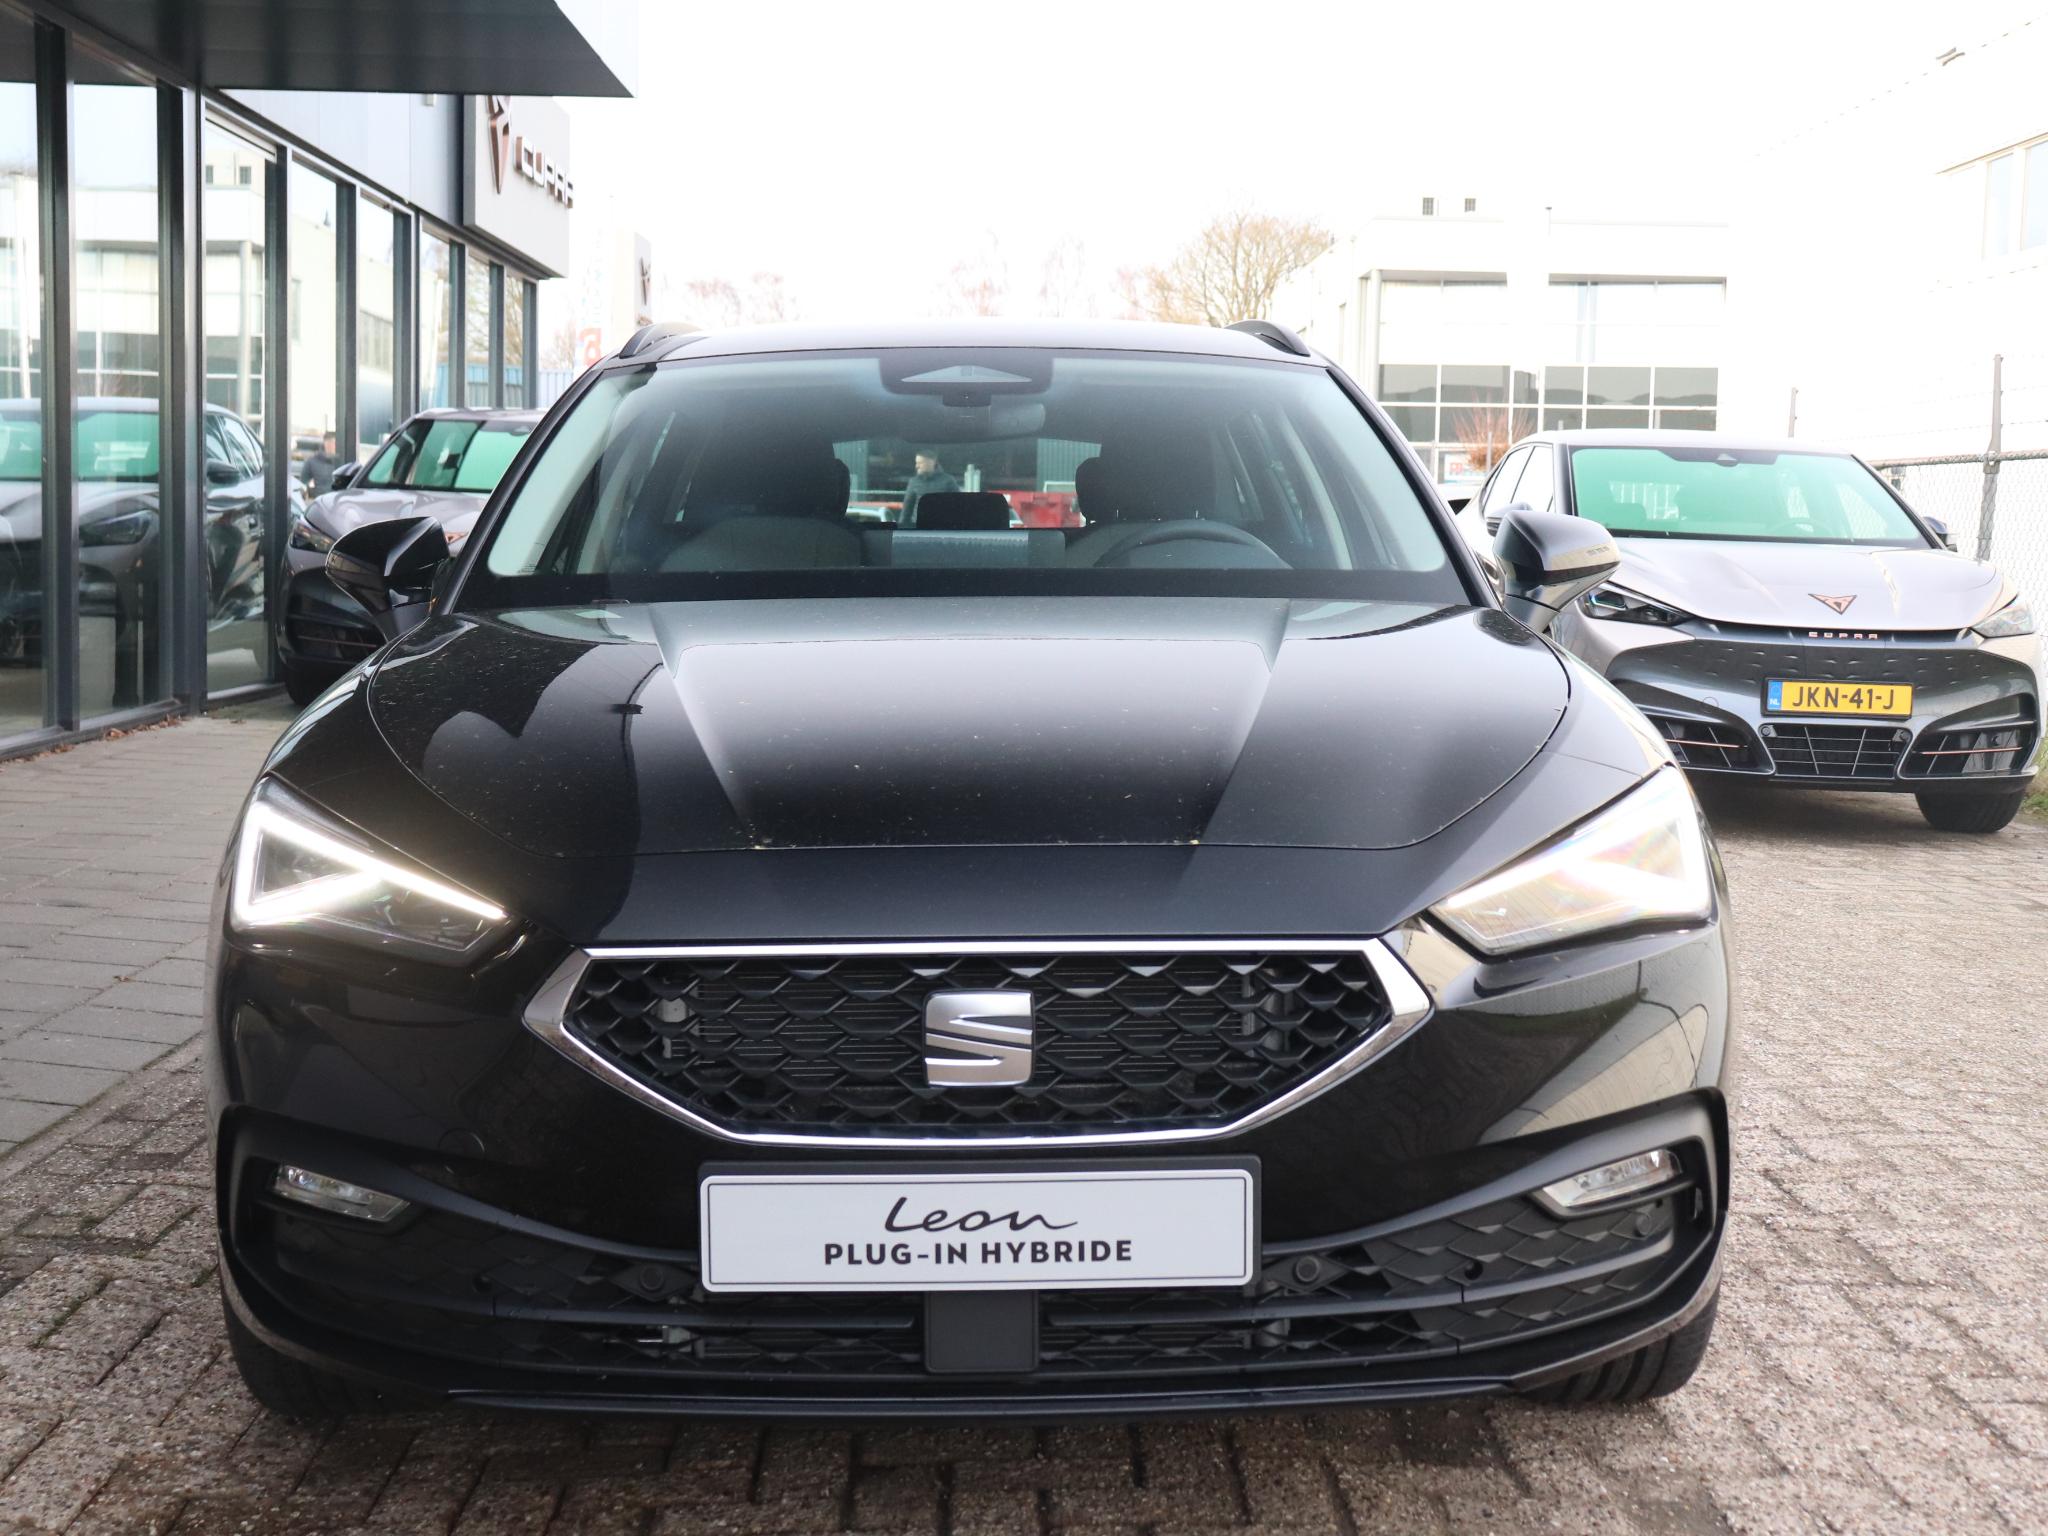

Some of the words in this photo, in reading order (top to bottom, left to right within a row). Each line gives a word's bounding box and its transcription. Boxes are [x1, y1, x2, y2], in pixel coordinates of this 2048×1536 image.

[1769, 698, 1780, 706] NL
[1792, 686, 1895, 710] JKN-41-J
[884, 1196, 1079, 1233] Leon
[824, 1242, 968, 1265] PLUG-IN
[981, 1239, 1133, 1264] HYBRIDE
